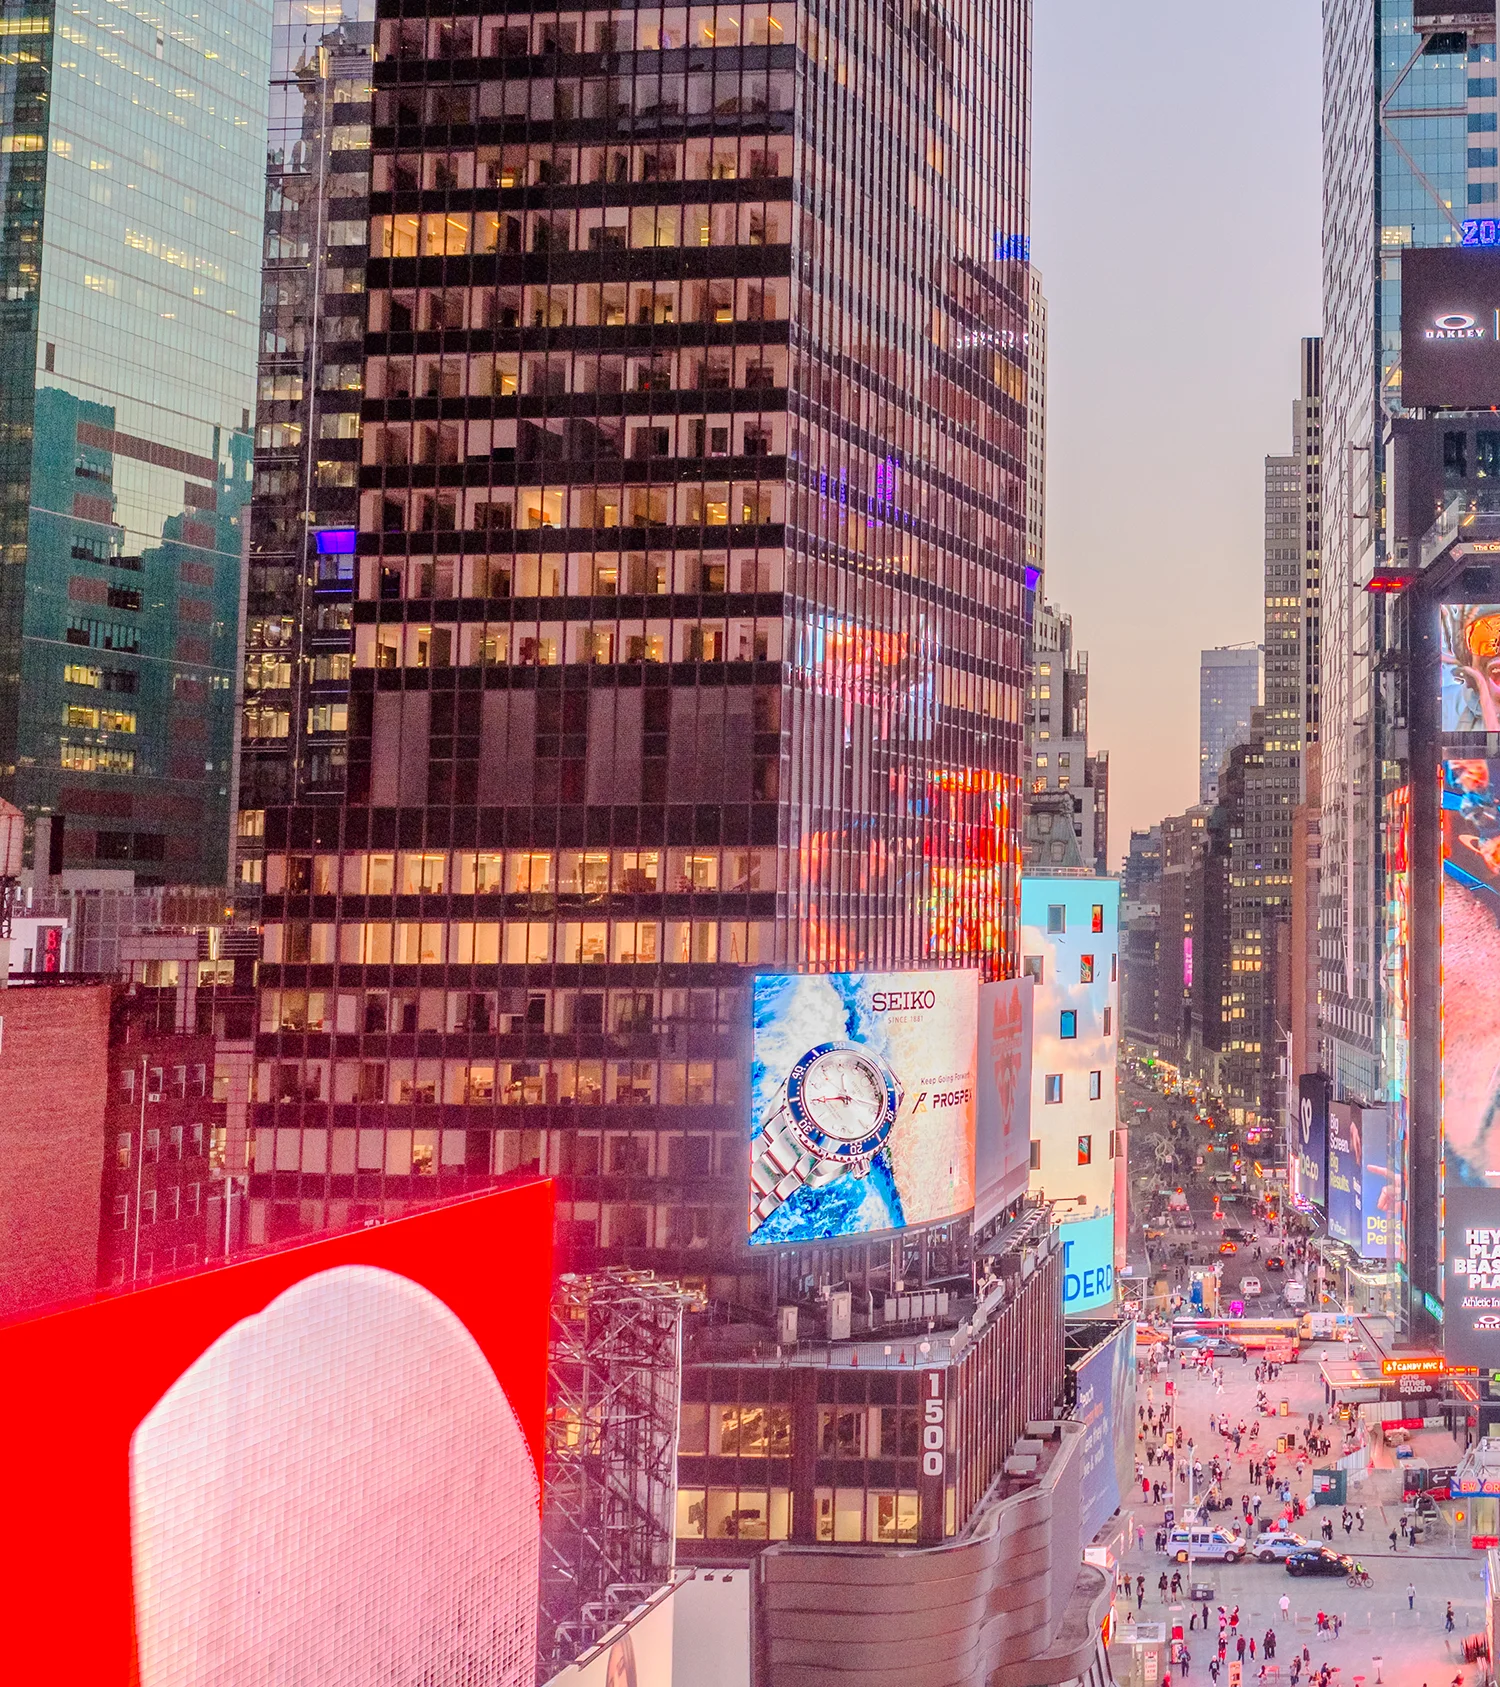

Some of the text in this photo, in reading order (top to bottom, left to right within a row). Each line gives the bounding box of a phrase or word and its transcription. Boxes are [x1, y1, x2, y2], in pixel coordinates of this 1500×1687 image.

[1425, 328, 1486, 339] OAKLEY
[871, 989, 936, 1013] SEIKO
[888, 1014, 924, 1025] SINCE 1881
[791, 1065, 804, 1080] 40
[920, 1077, 937, 1086] Keep
[937, 1074, 954, 1084] Going
[932, 1087, 973, 1109] PROSPEX
[798, 1118, 813, 1134] 30
[1330, 1112, 1339, 1134] Big
[850, 1144, 863, 1155] 20
[1462, 1296, 1491, 1307] Athletic
[1398, 1361, 1438, 1371] CANDY NYC
[1400, 1379, 1426, 1387] times
[1401, 1373, 1420, 1381] one
[1400, 1384, 1432, 1396] square
[922, 1372, 945, 1477] 1500
[1450, 1478, 1476, 1493] NEW
